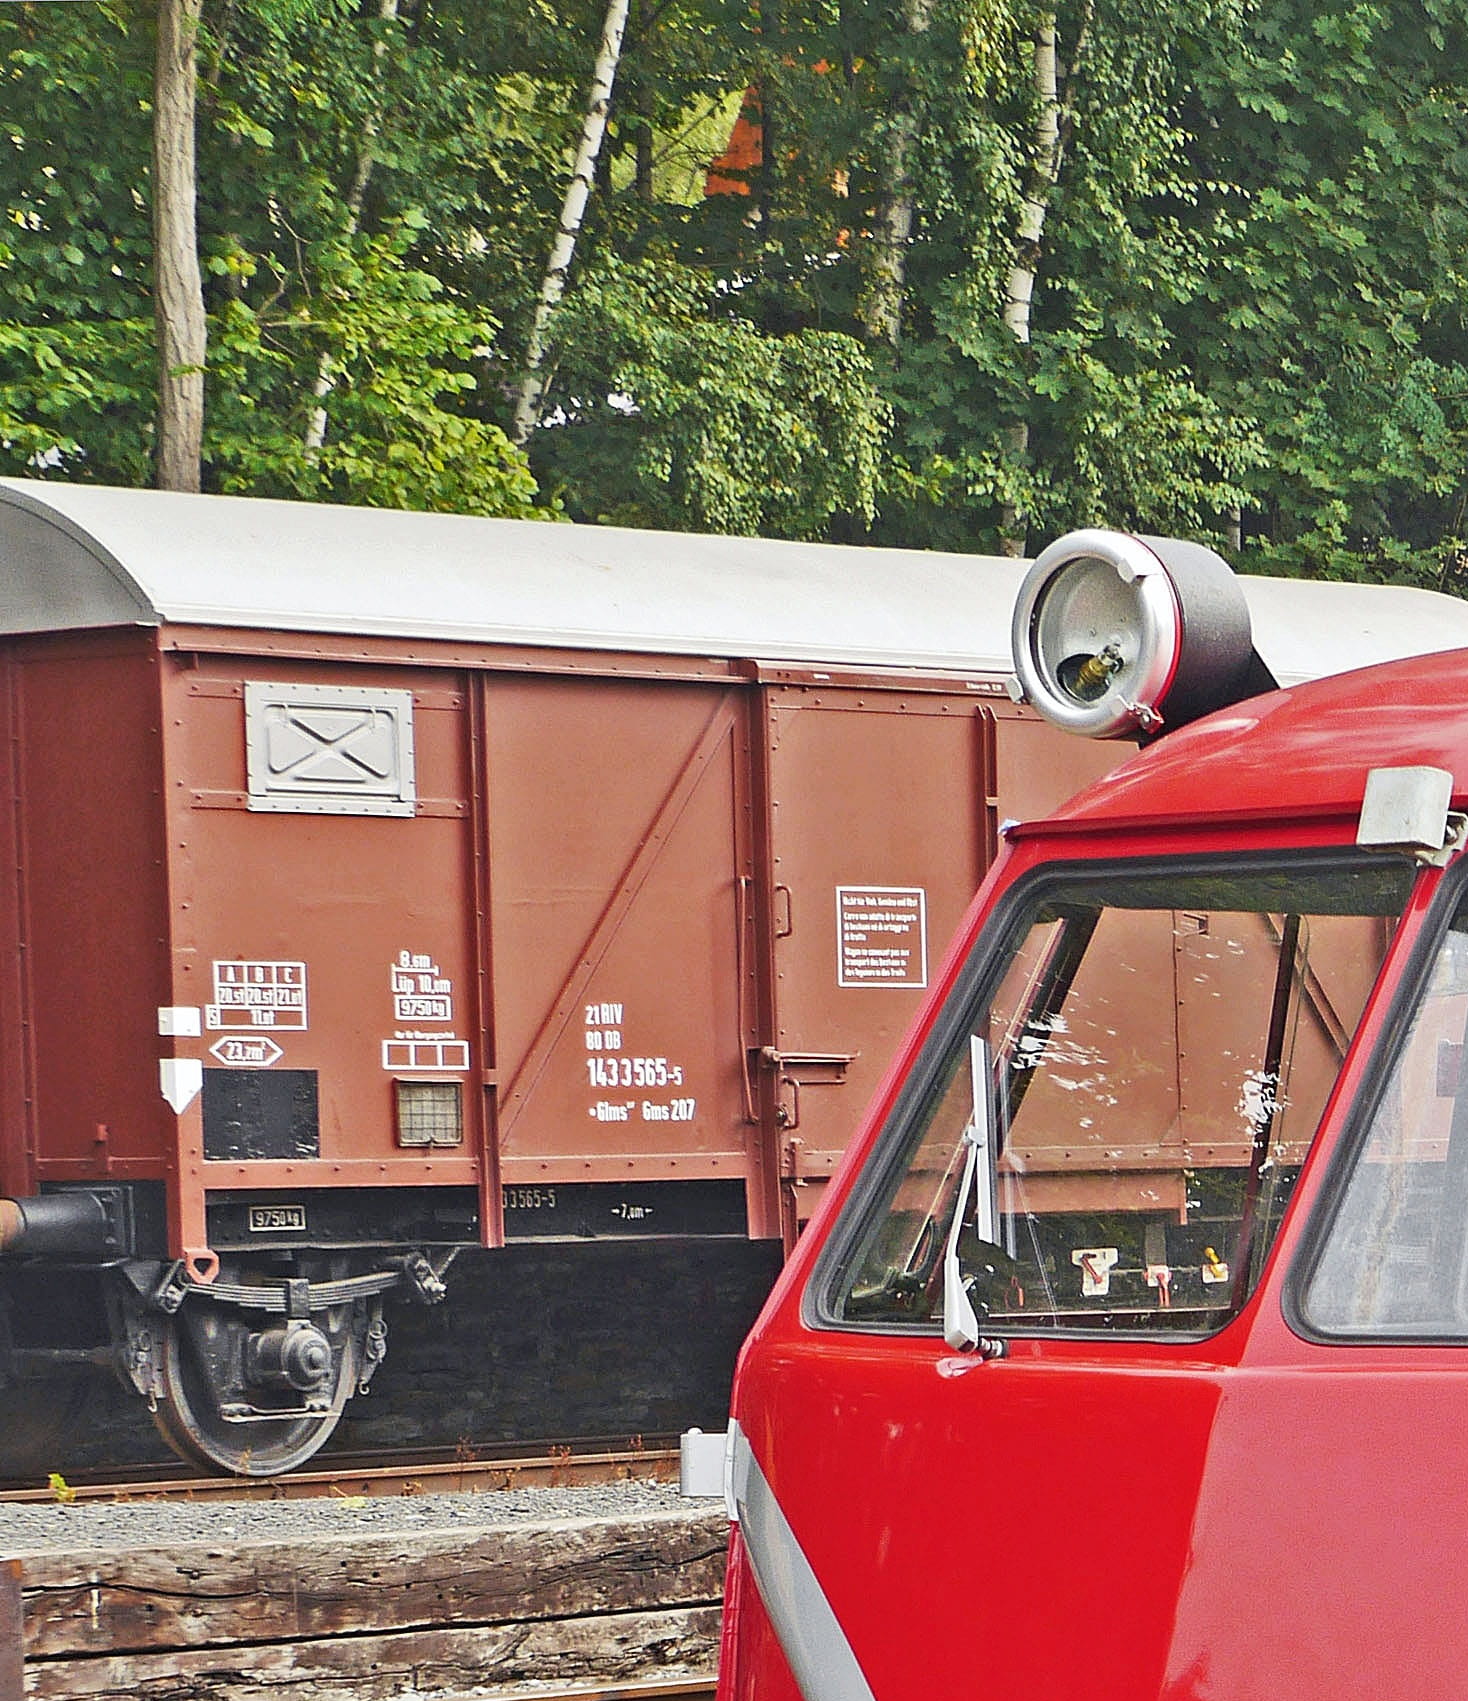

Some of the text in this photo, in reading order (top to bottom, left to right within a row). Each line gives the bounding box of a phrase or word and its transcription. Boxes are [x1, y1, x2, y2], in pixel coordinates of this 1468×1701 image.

[227, 966, 292, 983] A B C
[585, 1003, 622, 1025] 21 RIV
[671, 1098, 695, 1121] 207
